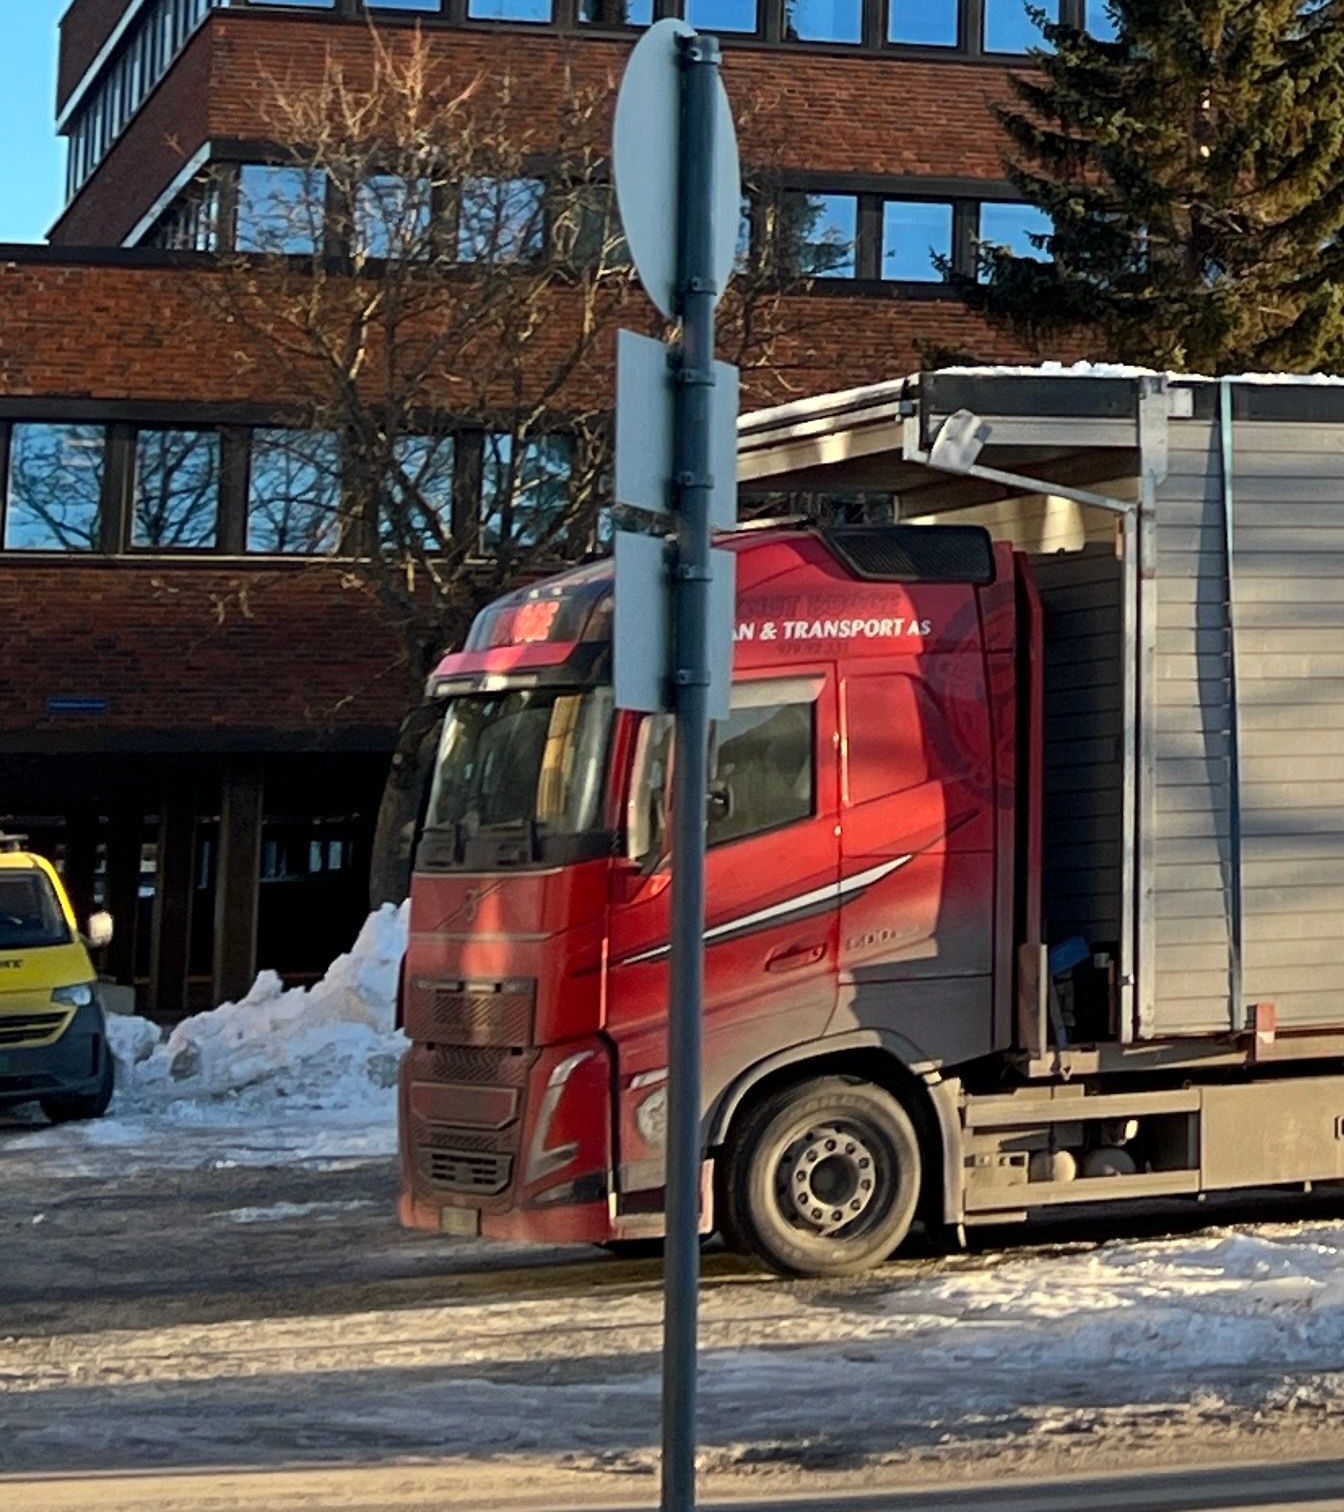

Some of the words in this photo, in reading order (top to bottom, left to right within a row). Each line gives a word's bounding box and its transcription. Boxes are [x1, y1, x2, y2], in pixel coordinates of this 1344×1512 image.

[759, 621, 777, 641] &
[783, 618, 904, 640] TRANSPORT
[906, 619, 932, 637] AS
